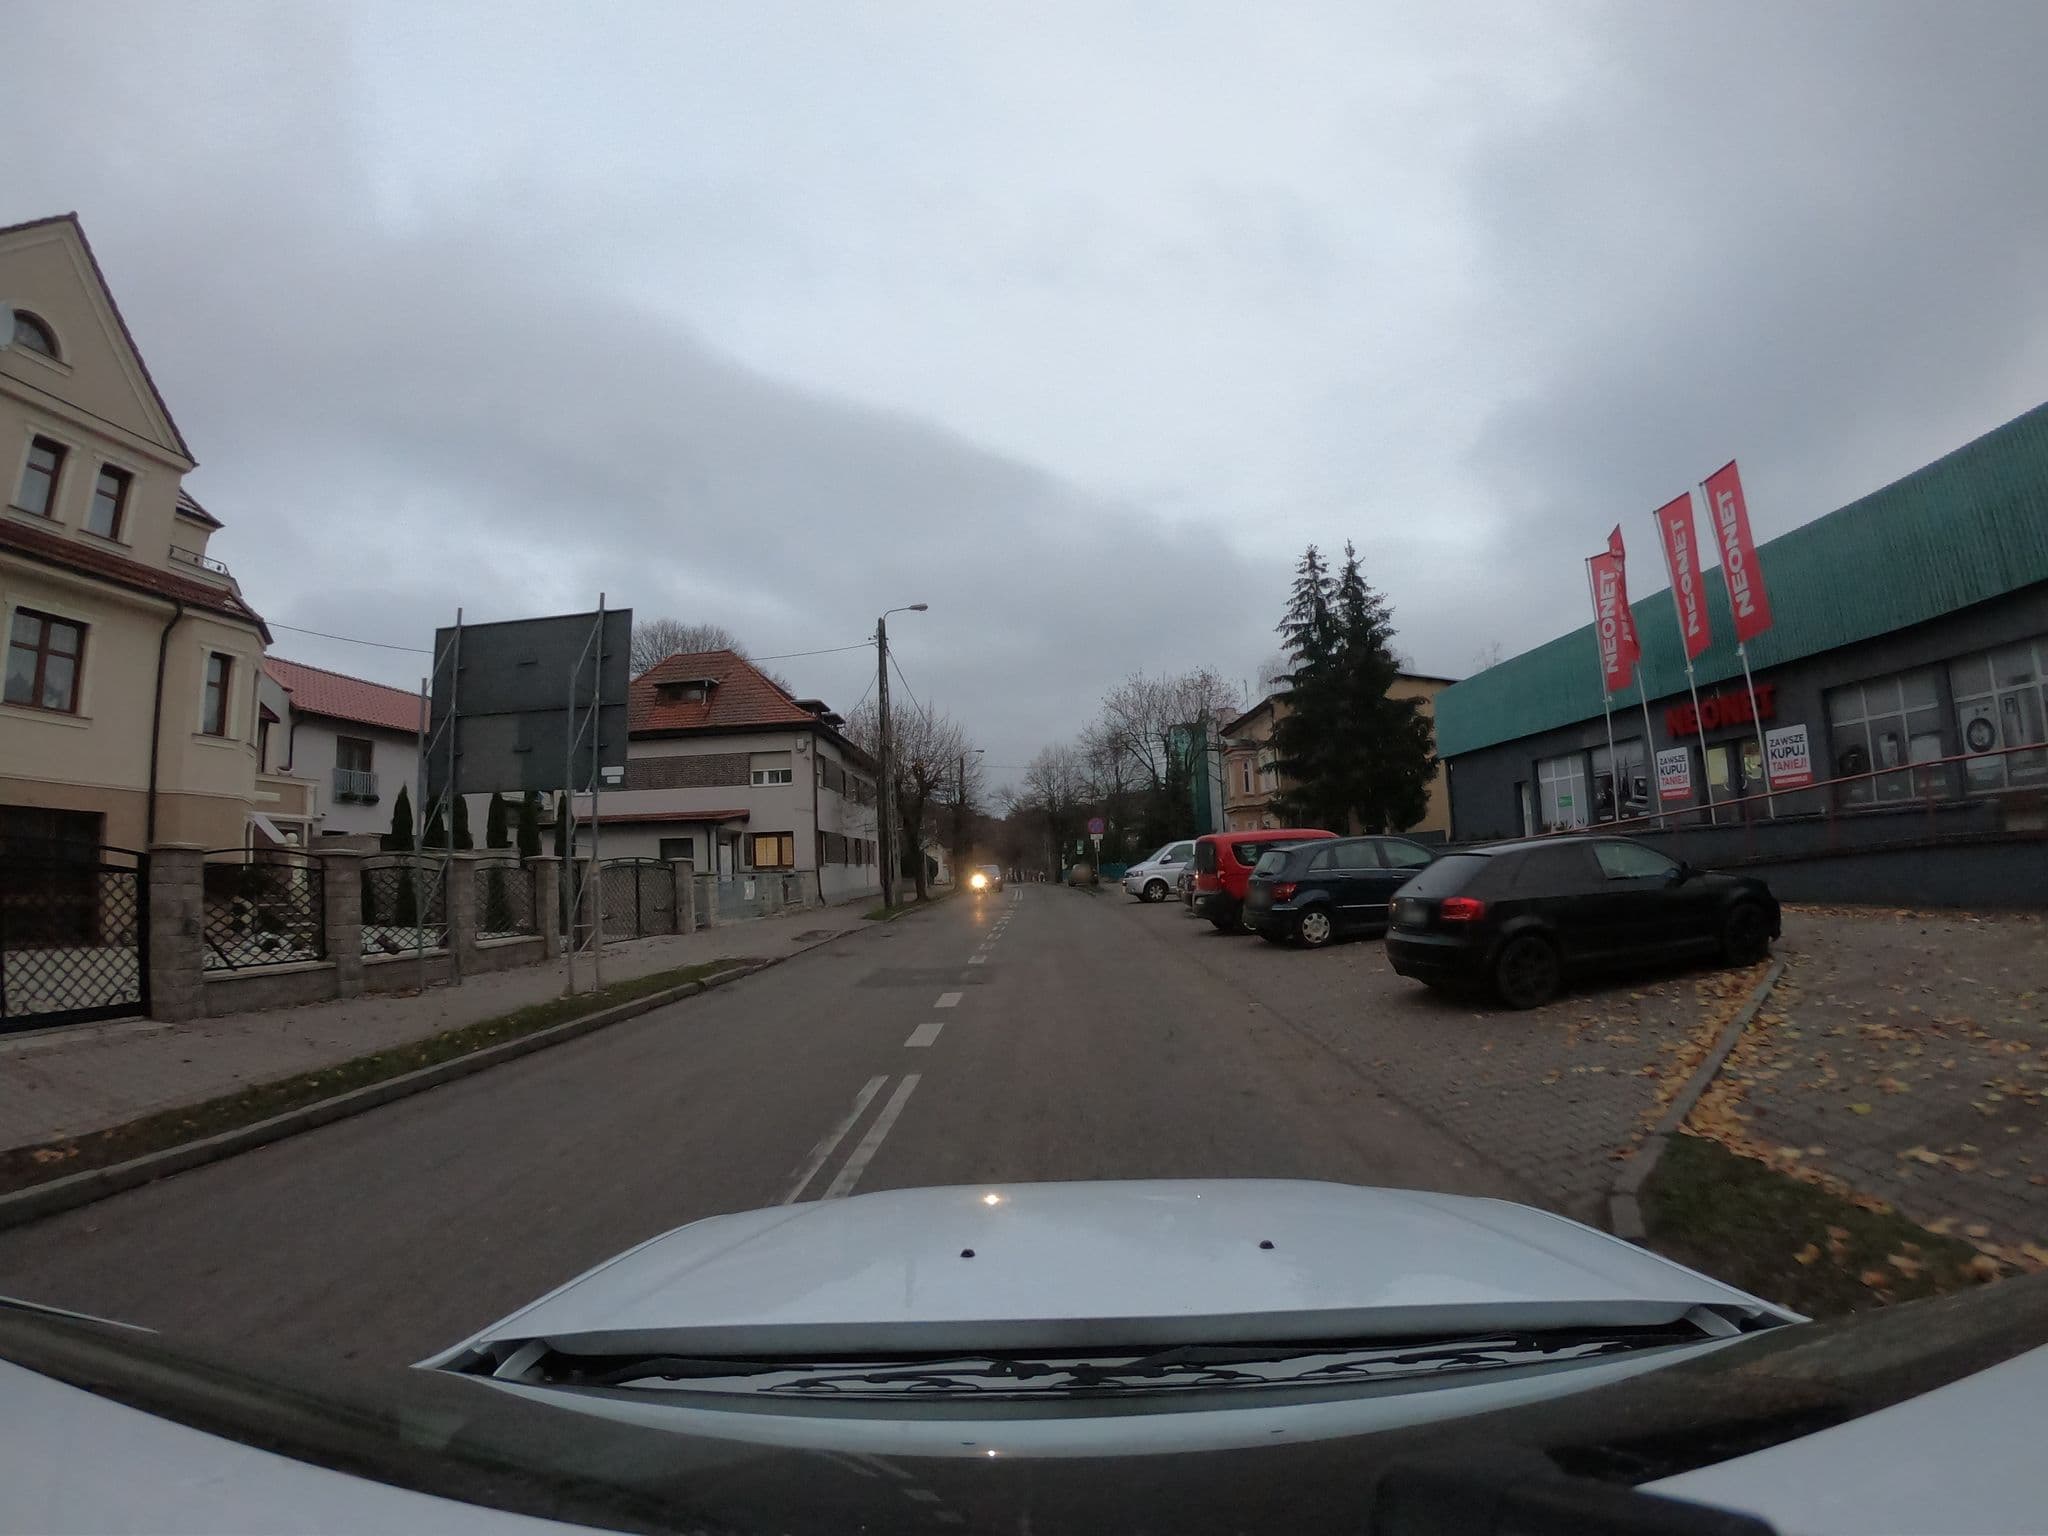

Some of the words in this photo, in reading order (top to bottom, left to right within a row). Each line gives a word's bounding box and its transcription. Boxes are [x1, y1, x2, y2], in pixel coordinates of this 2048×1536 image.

[1716, 489, 1756, 618] NEONET
[1670, 519, 1700, 637] NEONET
[1600, 569, 1619, 674] NEONET
[1663, 684, 1778, 737] NEONET
[1769, 733, 1805, 748] ZAWSZE
[1770, 743, 1806, 760] KUPUJ
[1659, 754, 1687, 765] ZAWSZE
[1659, 763, 1687, 776] KUPUJ
